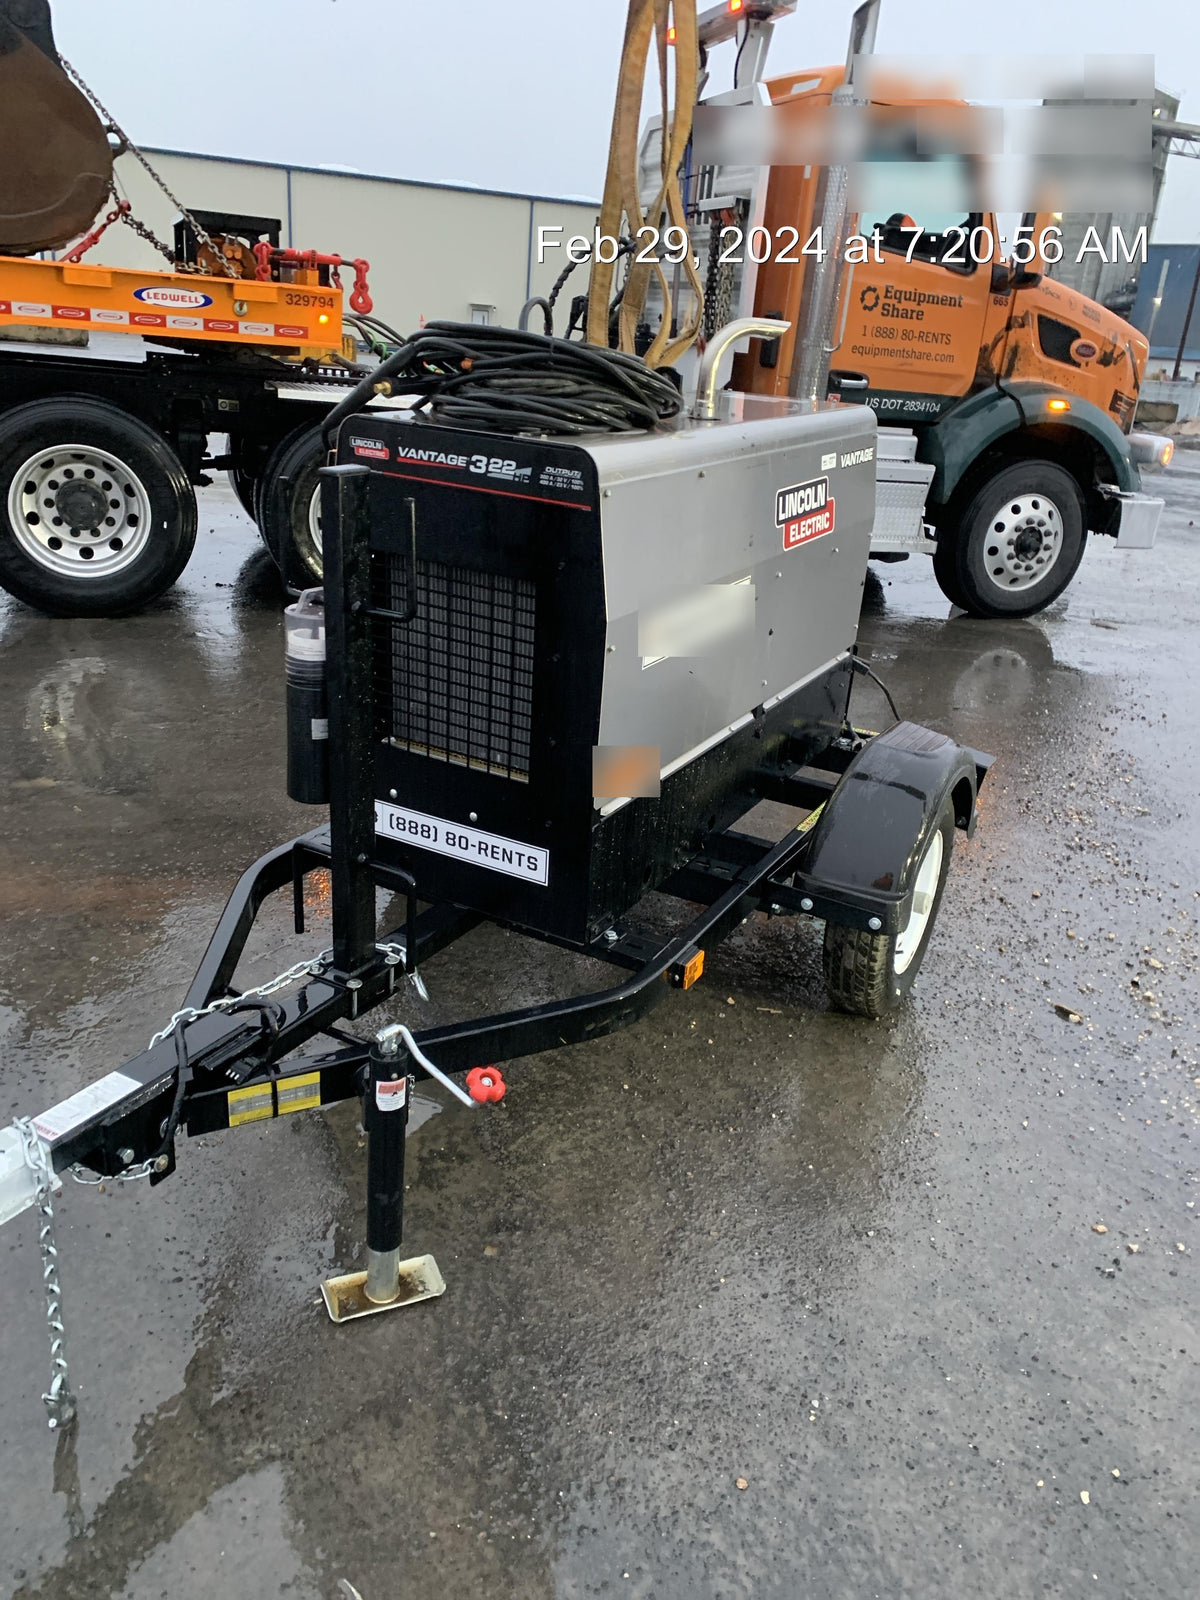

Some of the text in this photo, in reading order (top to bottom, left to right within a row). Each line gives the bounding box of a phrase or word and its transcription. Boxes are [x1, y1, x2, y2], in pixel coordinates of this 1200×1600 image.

[145, 291, 201, 304] LEDWELL
[285, 293, 335, 309] 329794
[884, 284, 963, 308] Equipment
[881, 303, 925, 321] Share
[862, 325, 952, 345] 1 (888) 80-RENTS
[851, 343, 955, 363] equipmentshare.com
[865, 397, 941, 413] US DOT 2834104
[351, 438, 382, 450] LINCOLN
[398, 446, 517, 475] VANTAGE 322
[840, 447, 875, 469] VANTAGE
[778, 482, 827, 521] LINCOLN
[789, 511, 830, 543] ELECTRIC
[388, 813, 539, 872] (888) 80-RENTS
